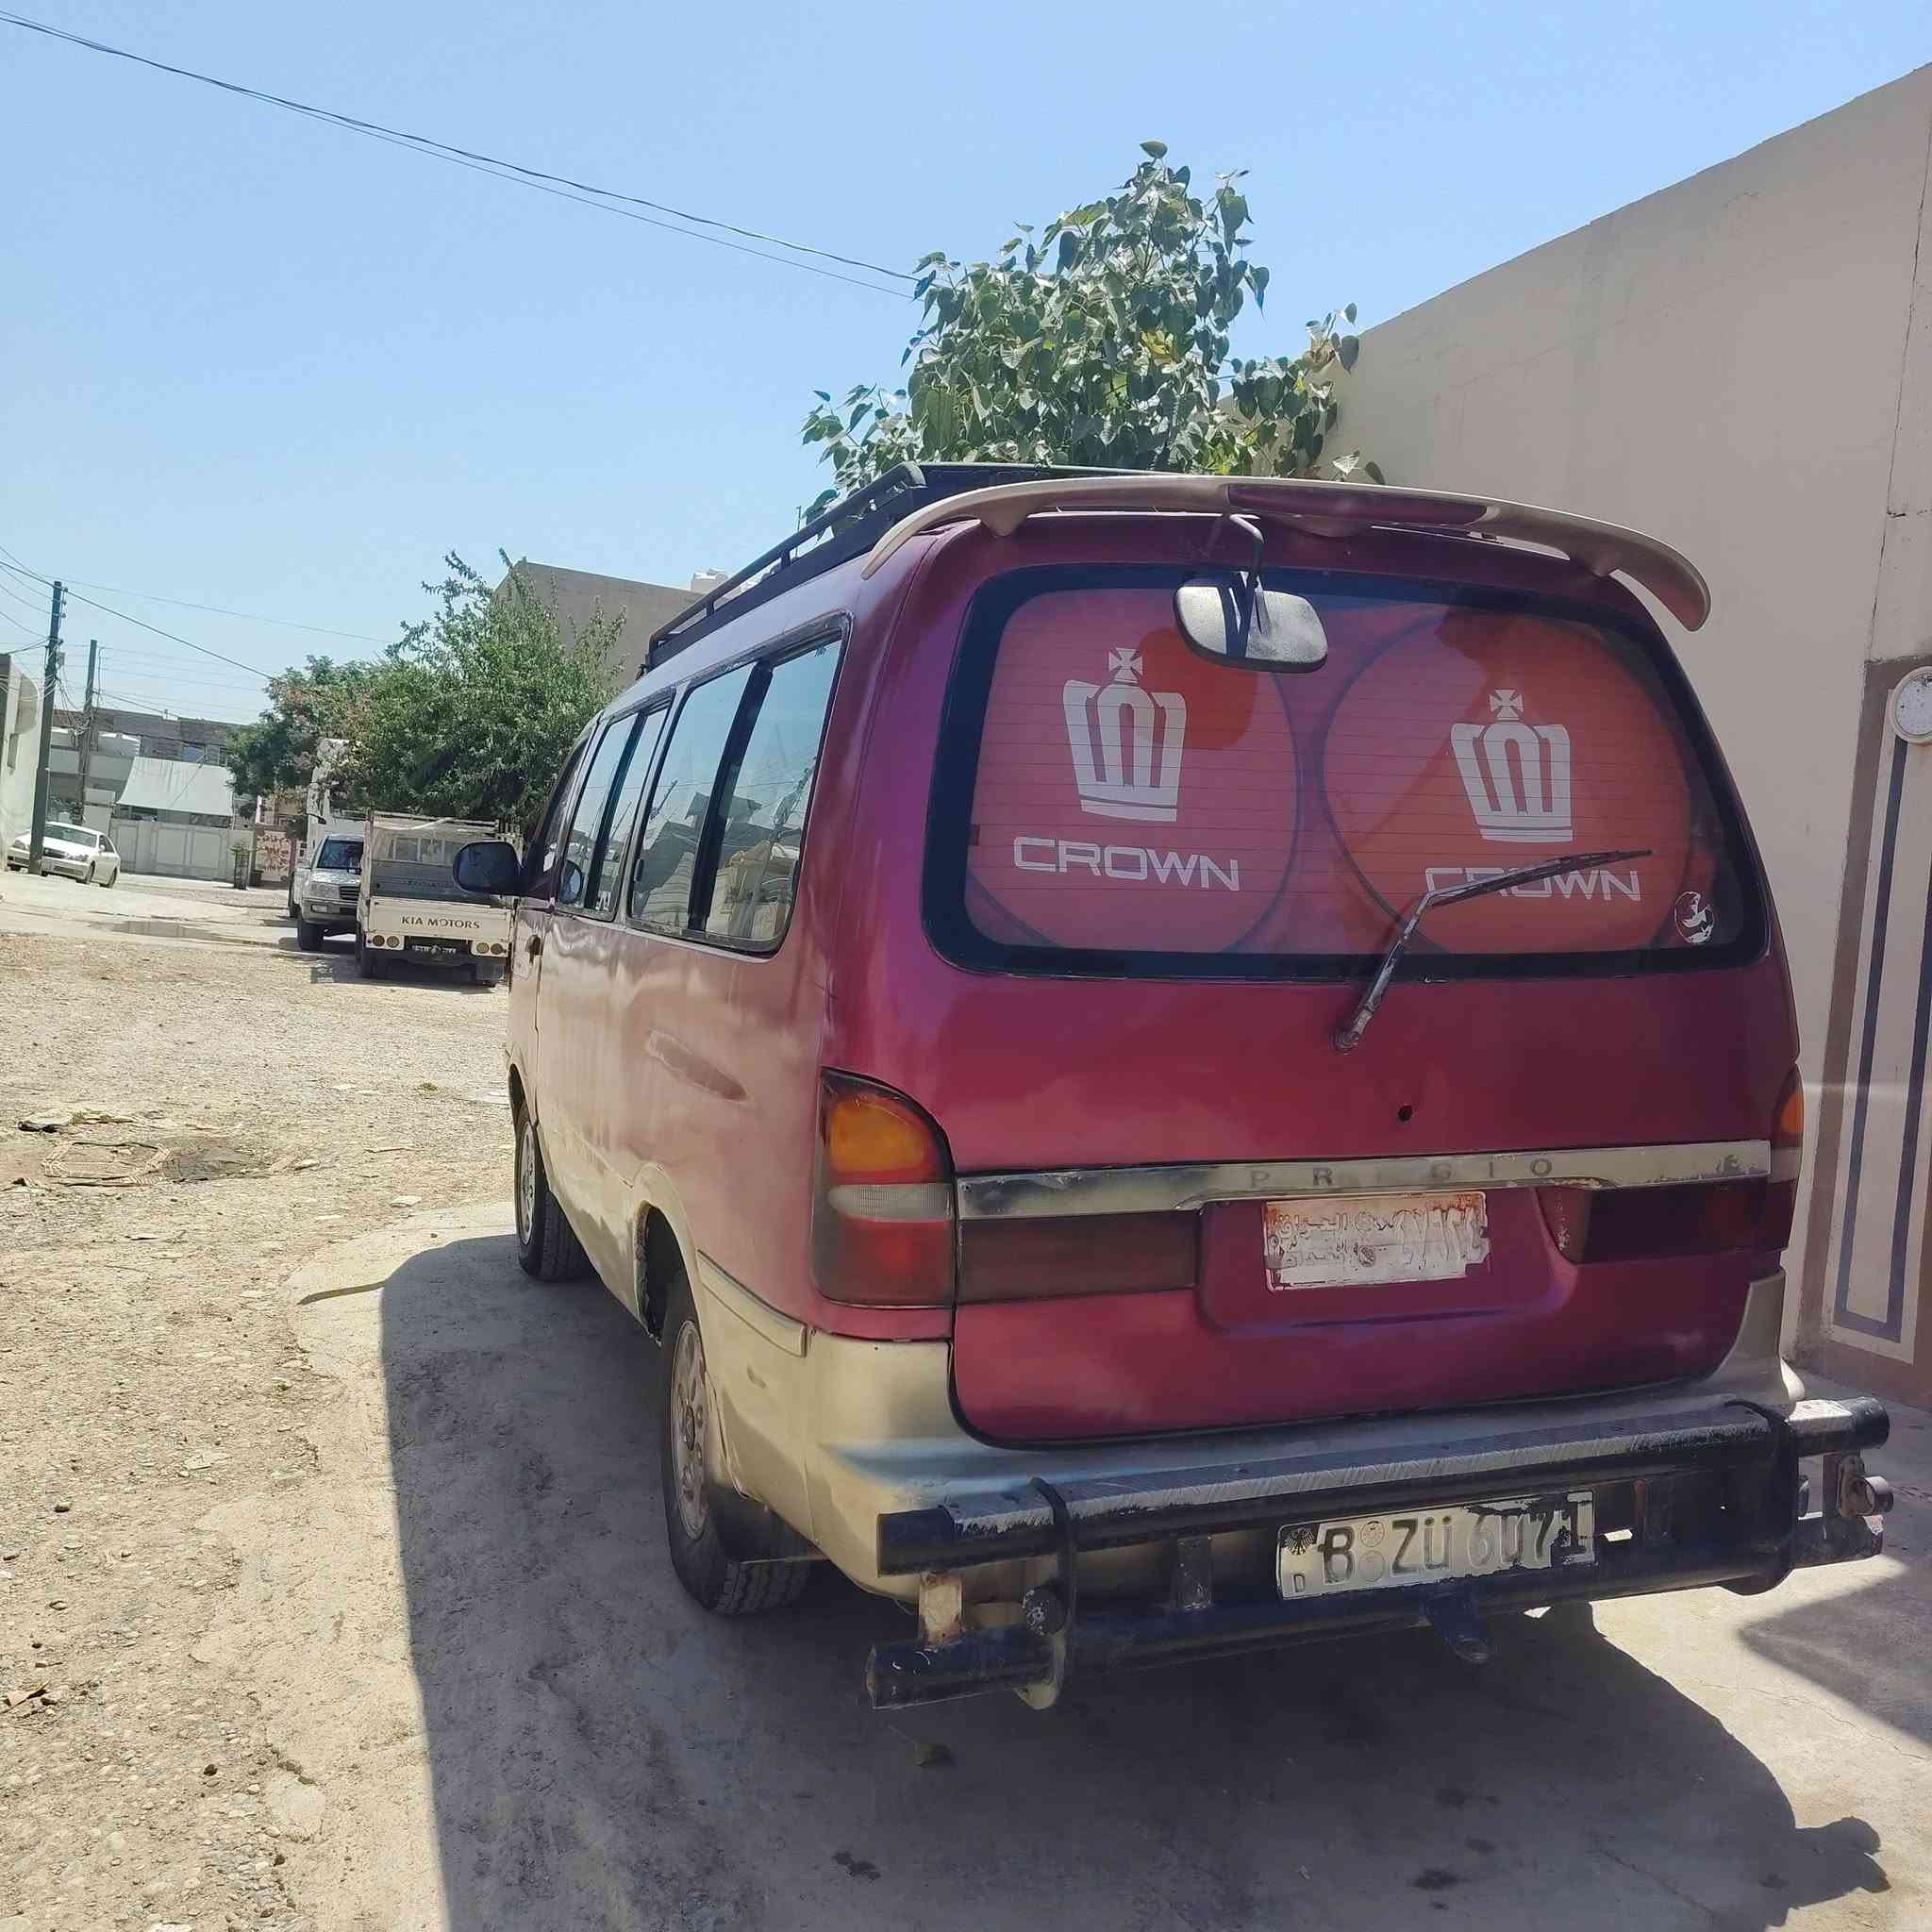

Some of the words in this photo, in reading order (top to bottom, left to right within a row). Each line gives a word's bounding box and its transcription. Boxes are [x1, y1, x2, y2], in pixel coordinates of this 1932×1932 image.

[1013, 836, 1241, 891] CROWN
[401, 915, 424, 926] KIA
[427, 918, 481, 929] MOTORS
